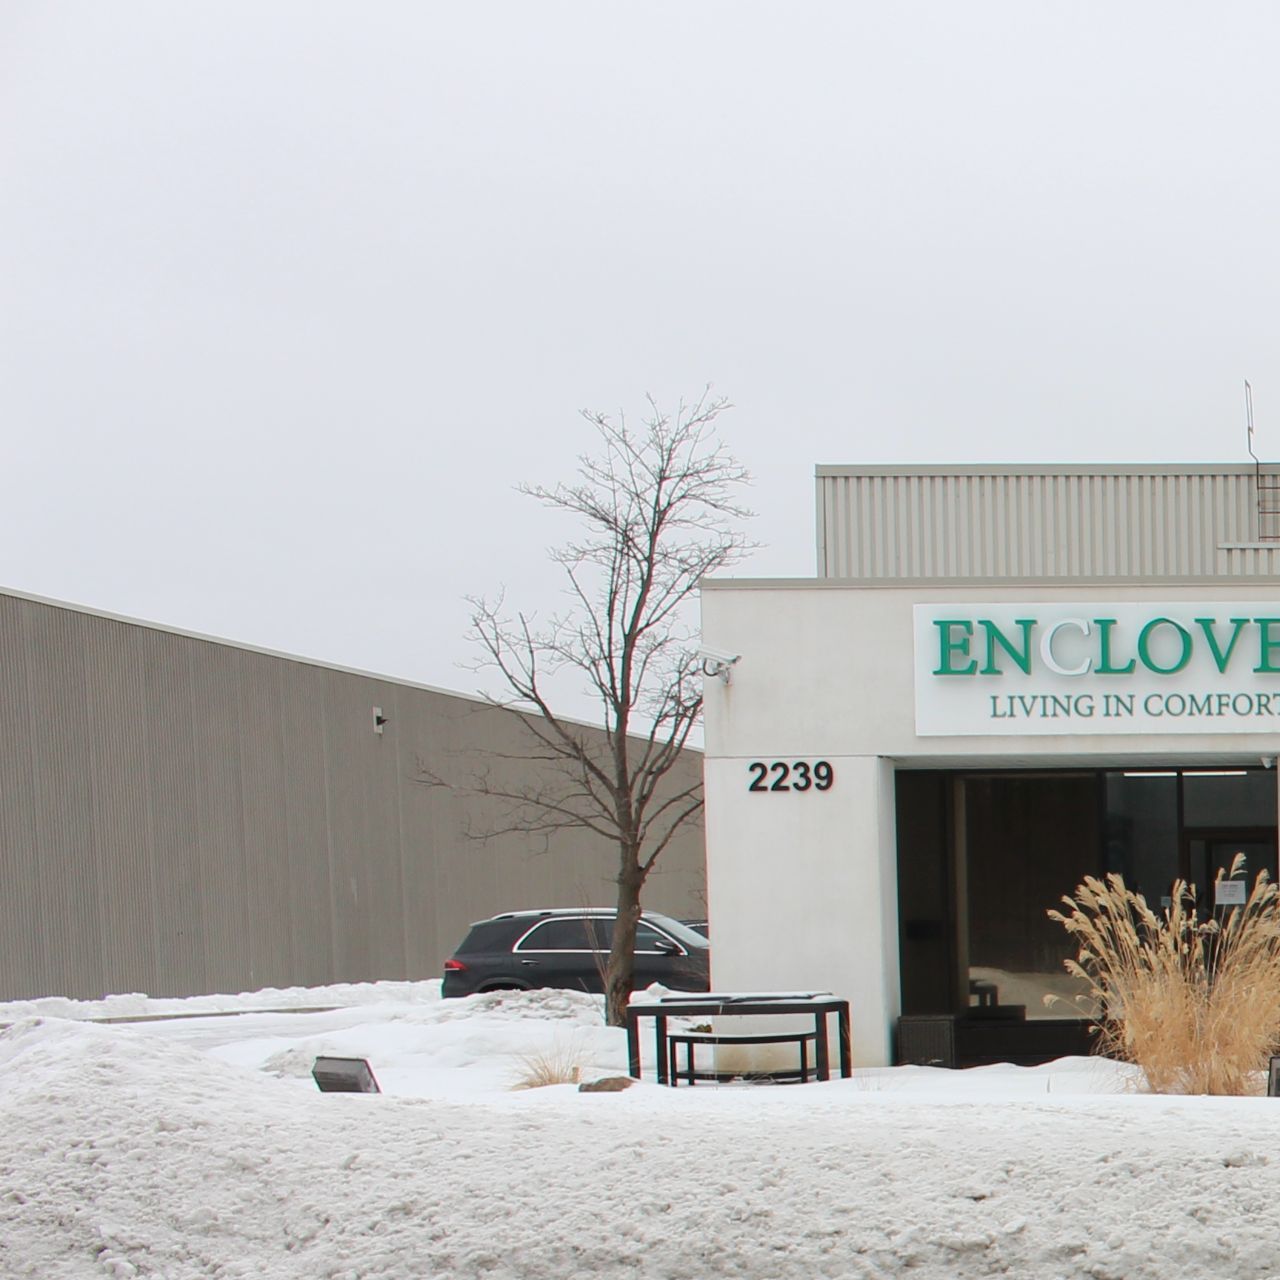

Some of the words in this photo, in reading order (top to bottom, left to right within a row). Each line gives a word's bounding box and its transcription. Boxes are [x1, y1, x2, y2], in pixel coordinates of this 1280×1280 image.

[990, 694, 1095, 719] LIVING
[1102, 694, 1136, 717] IN
[748, 760, 834, 792] 2239
